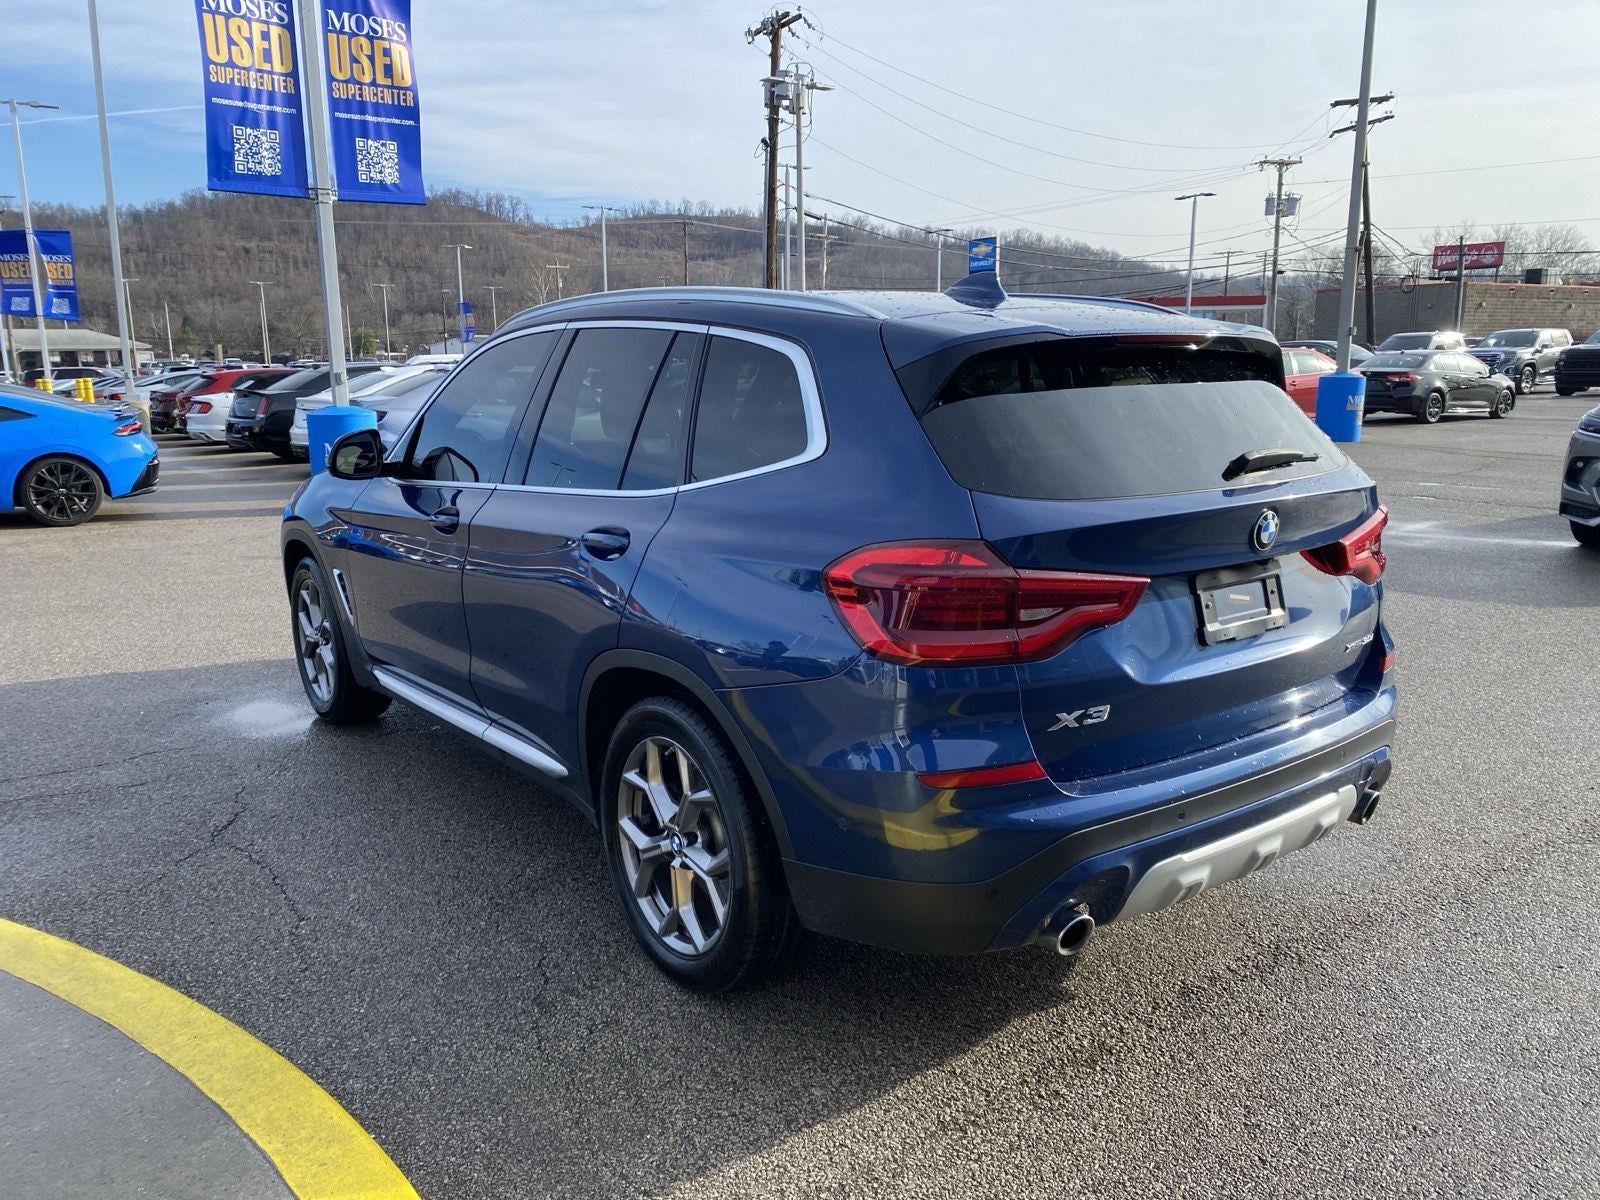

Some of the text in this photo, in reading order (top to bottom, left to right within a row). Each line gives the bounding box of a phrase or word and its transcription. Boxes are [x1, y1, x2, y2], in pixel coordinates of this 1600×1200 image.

[202, 0, 288, 24] MOSES
[327, 10, 407, 42] MOSES
[202, 13, 293, 73] USED
[328, 33, 412, 87] USED
[209, 65, 295, 94] SUPERCENTER
[211, 97, 297, 115] mosesusedsupercenter.com
[332, 82, 414, 106] SUPERCENTER
[334, 112, 415, 126] mosesusedsupercenter.com
[41, 254, 72, 262] OSES
[1047, 705, 1111, 732] X3
